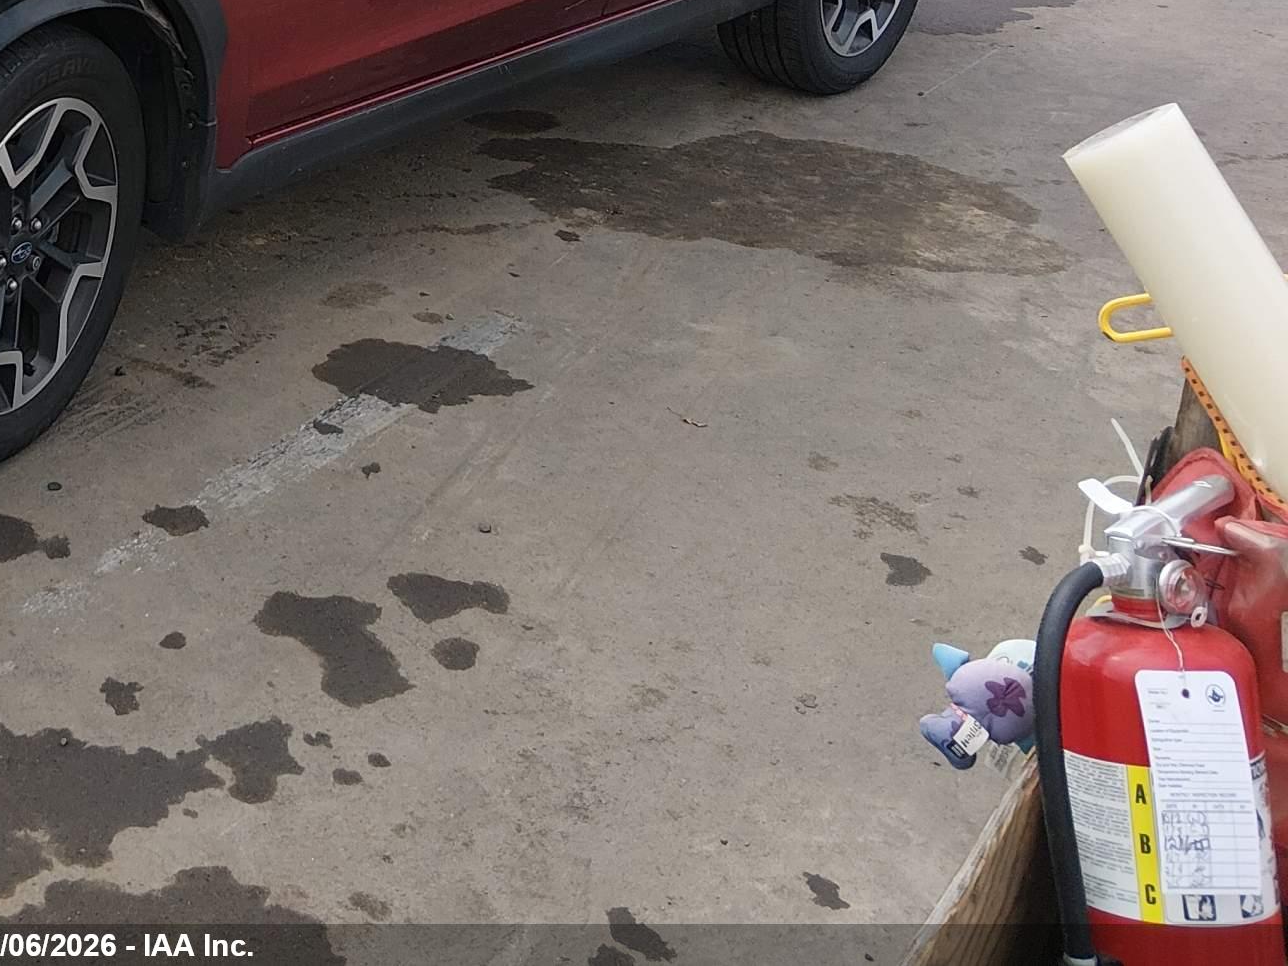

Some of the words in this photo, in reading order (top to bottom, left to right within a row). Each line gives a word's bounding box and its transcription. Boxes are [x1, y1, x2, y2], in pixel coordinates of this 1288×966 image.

[1135, 783, 1147, 805] A
[1139, 833, 1151, 854] B
[1144, 883, 1157, 905] C
